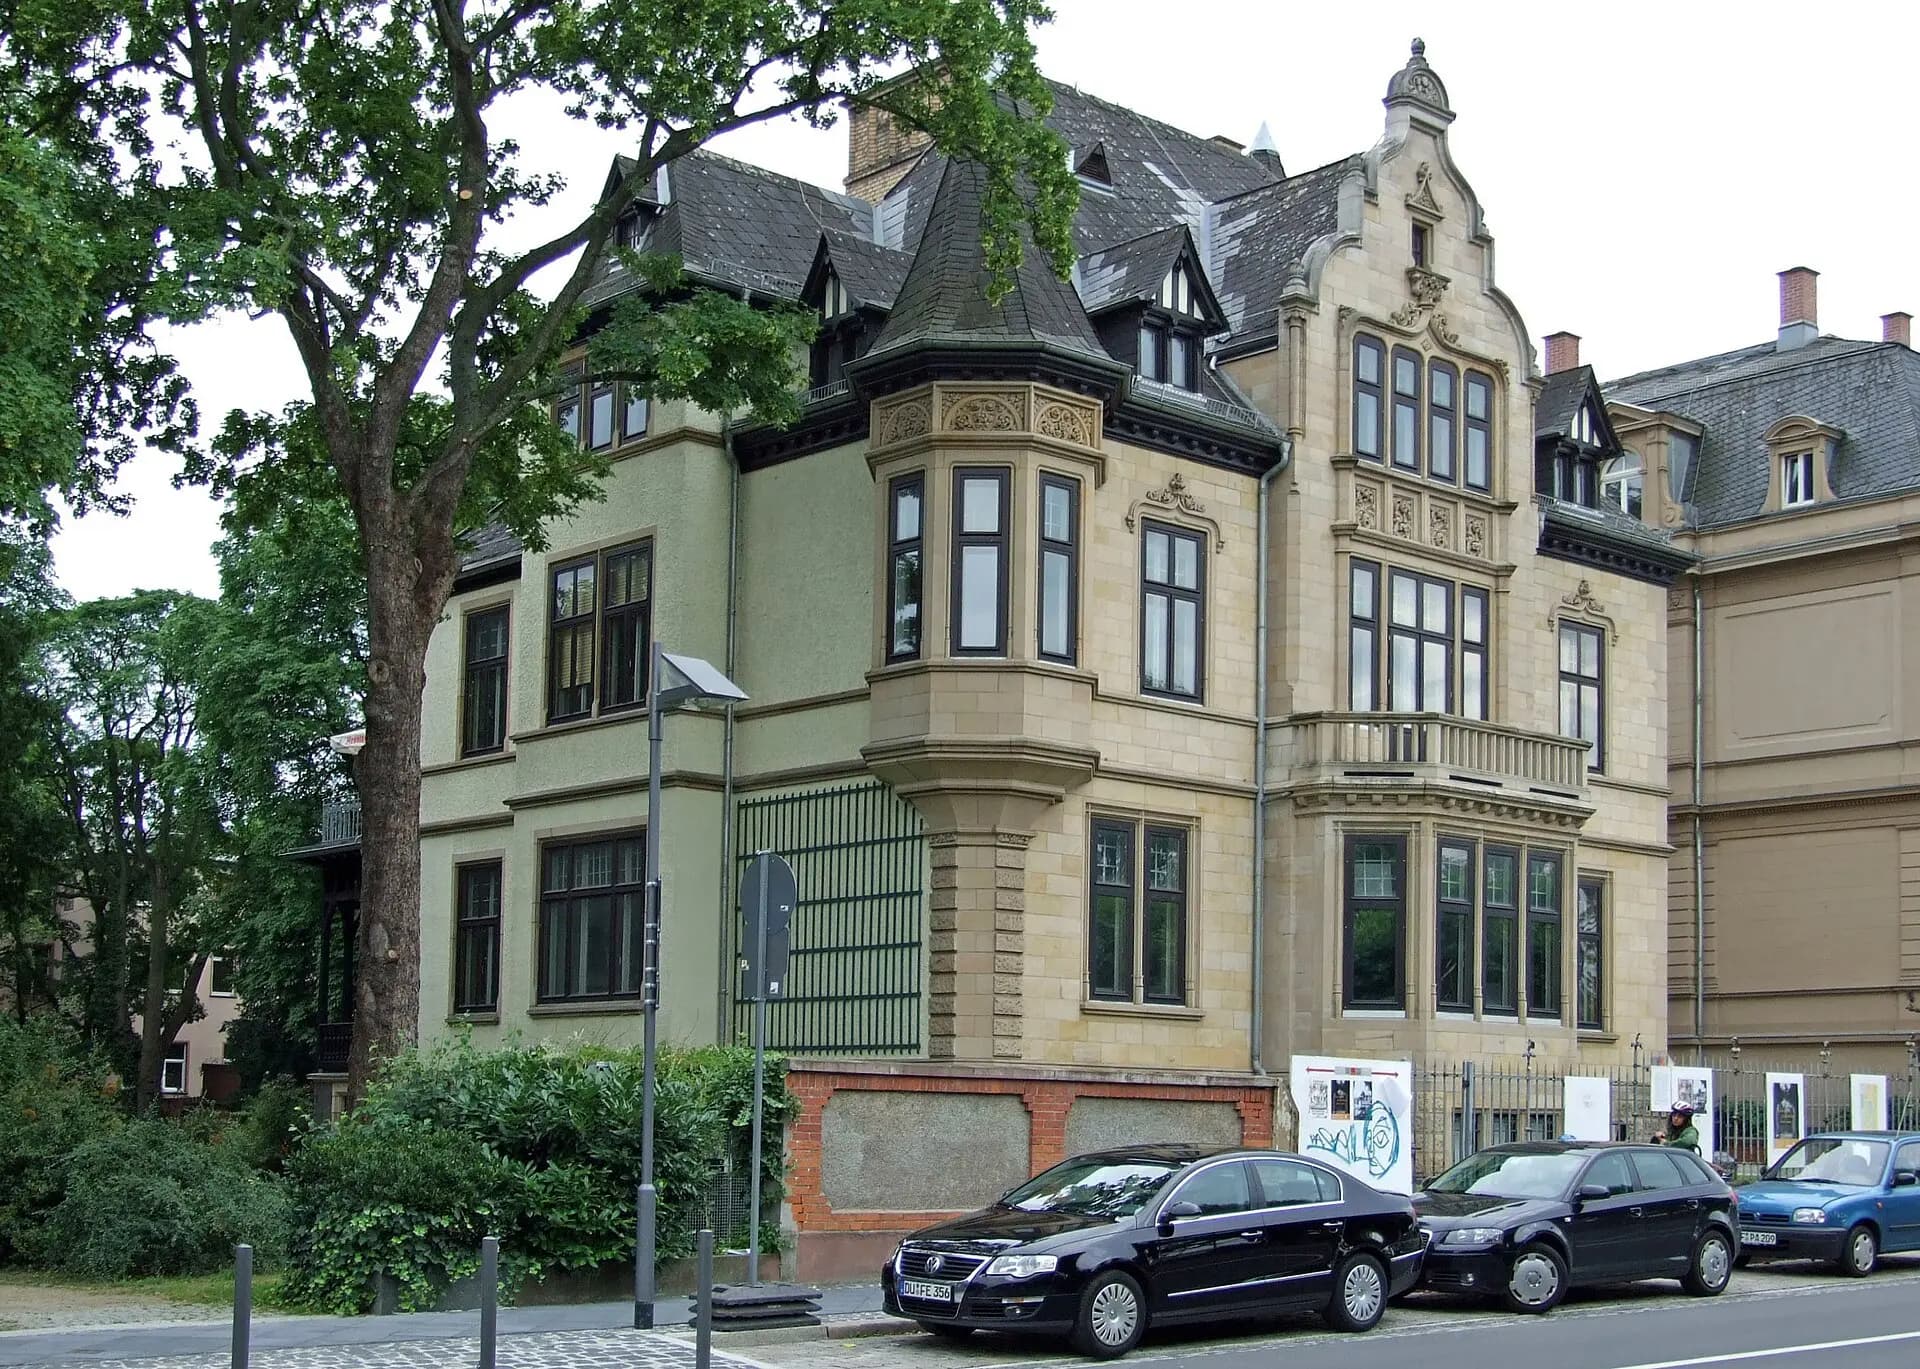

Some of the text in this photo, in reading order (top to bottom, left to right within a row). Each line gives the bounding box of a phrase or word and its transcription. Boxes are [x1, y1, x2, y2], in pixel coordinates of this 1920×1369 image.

[904, 1282, 950, 1299] DU FE 356
